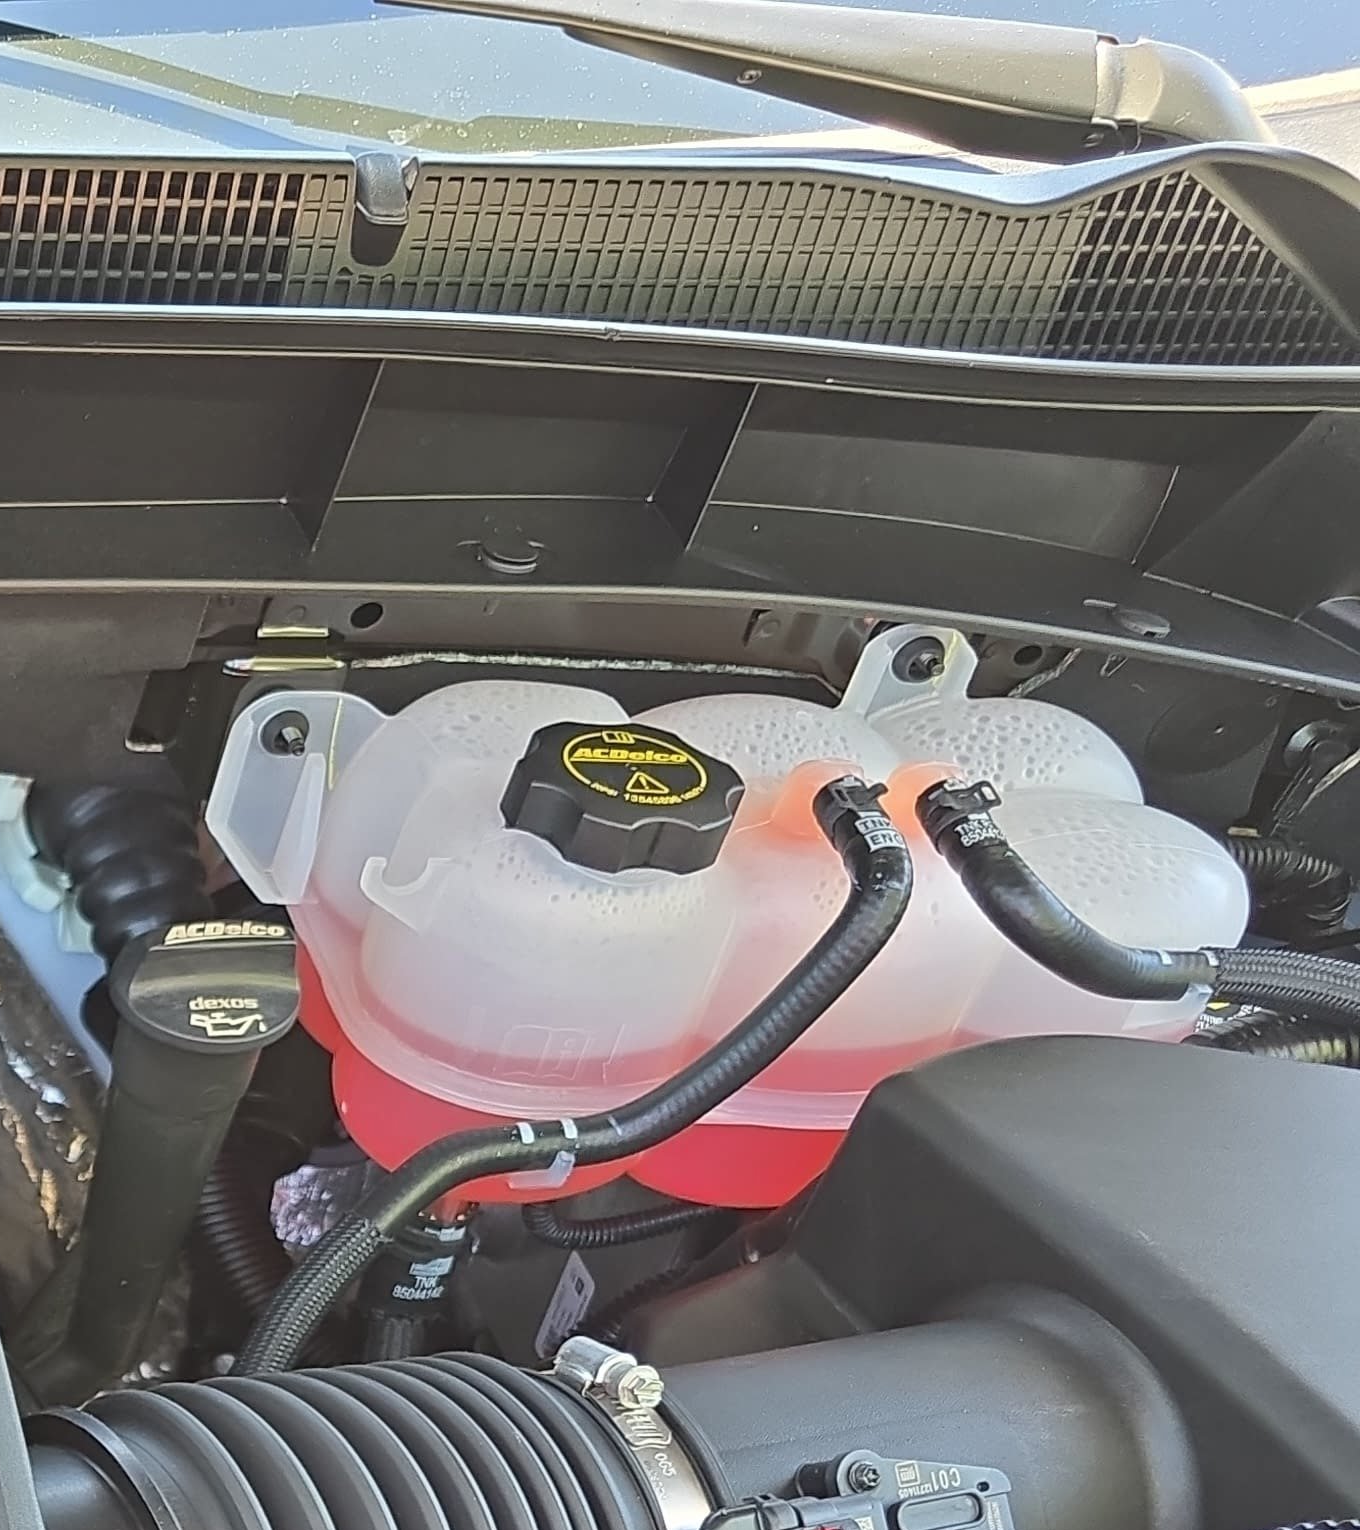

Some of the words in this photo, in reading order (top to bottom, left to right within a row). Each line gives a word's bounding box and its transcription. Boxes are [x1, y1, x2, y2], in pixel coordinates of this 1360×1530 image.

[572, 747, 688, 763] ACDelco
[164, 921, 286, 941] ACDelco
[188, 996, 259, 1011] dexos
